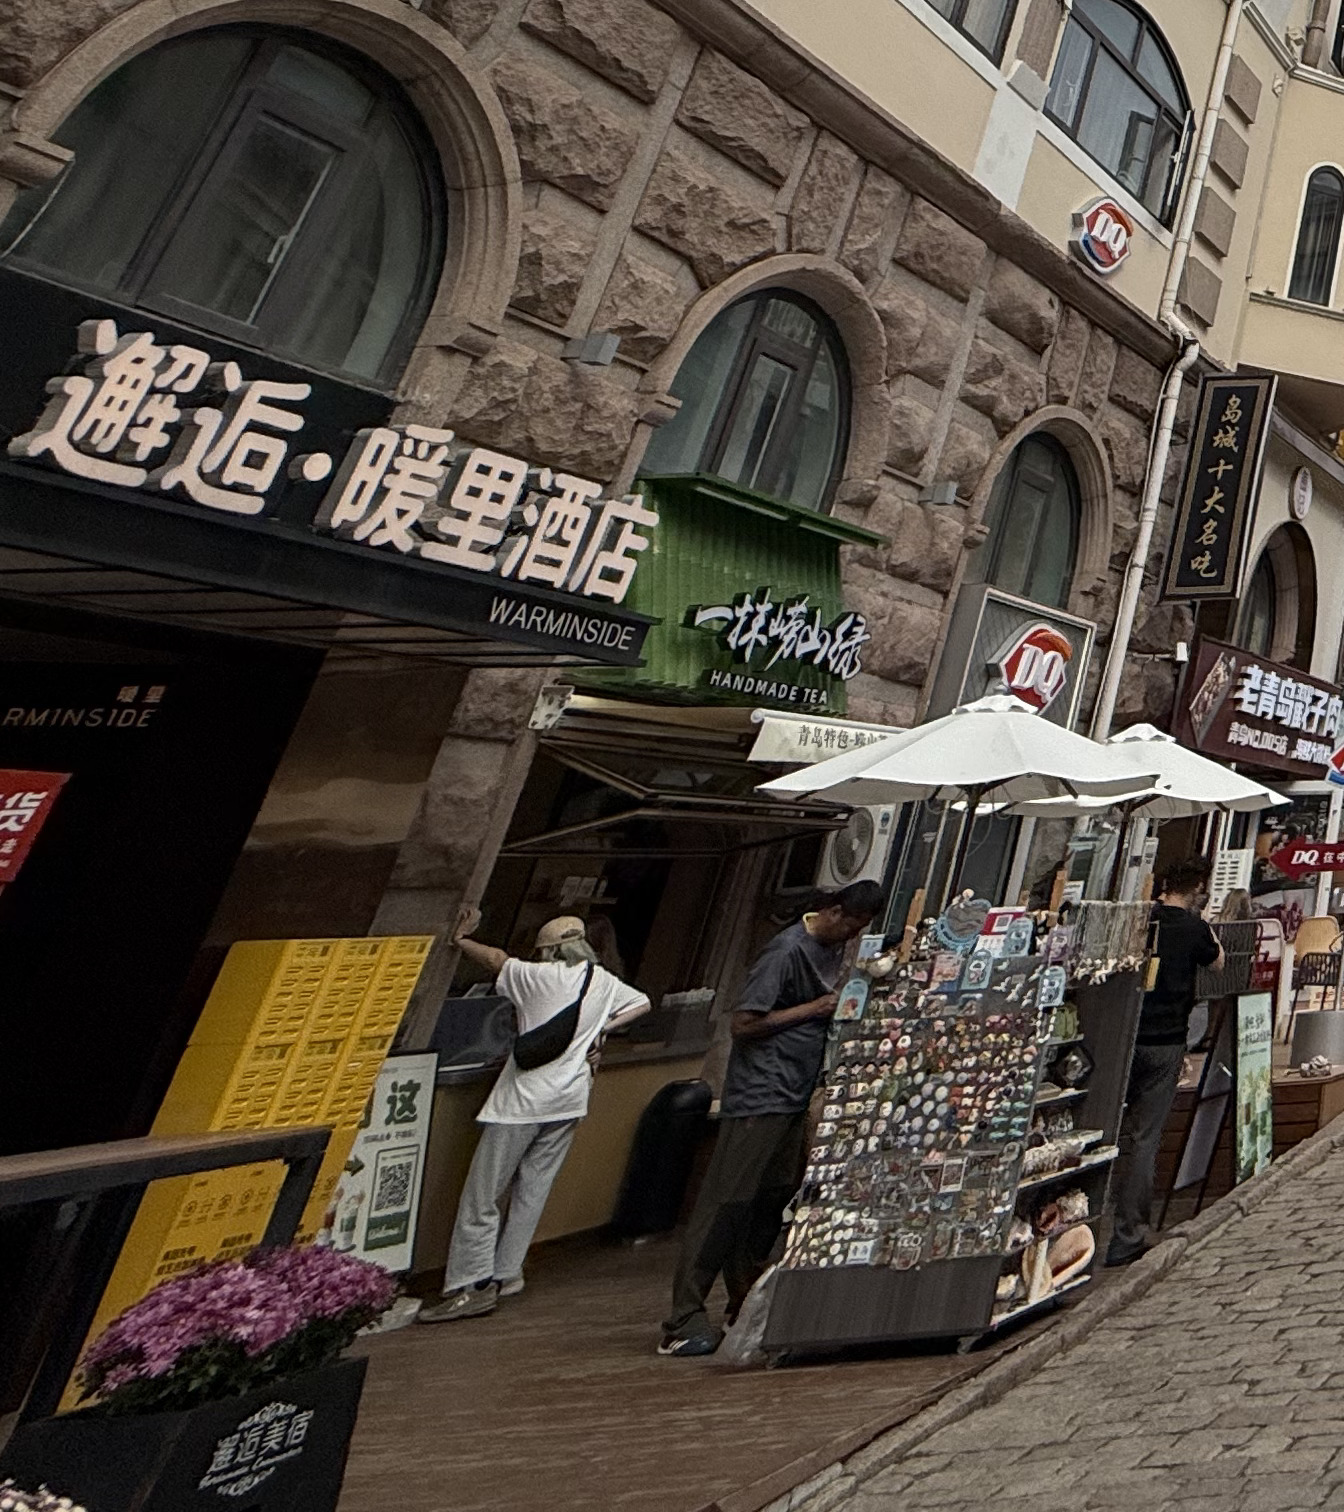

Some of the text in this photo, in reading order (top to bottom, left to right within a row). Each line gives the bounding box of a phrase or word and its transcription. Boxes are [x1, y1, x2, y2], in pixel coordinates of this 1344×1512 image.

[1090, 209, 1127, 260] DQ
[26, 318, 660, 605] 邂逅·暖里酒店
[1190, 393, 1243, 578] 岛城十大名吃
[488, 596, 636, 651] WARMINSIDE
[709, 669, 829, 705] HANDMADE TEA
[1010, 642, 1065, 703] DQ
[1290, 849, 1320, 866] DQ
